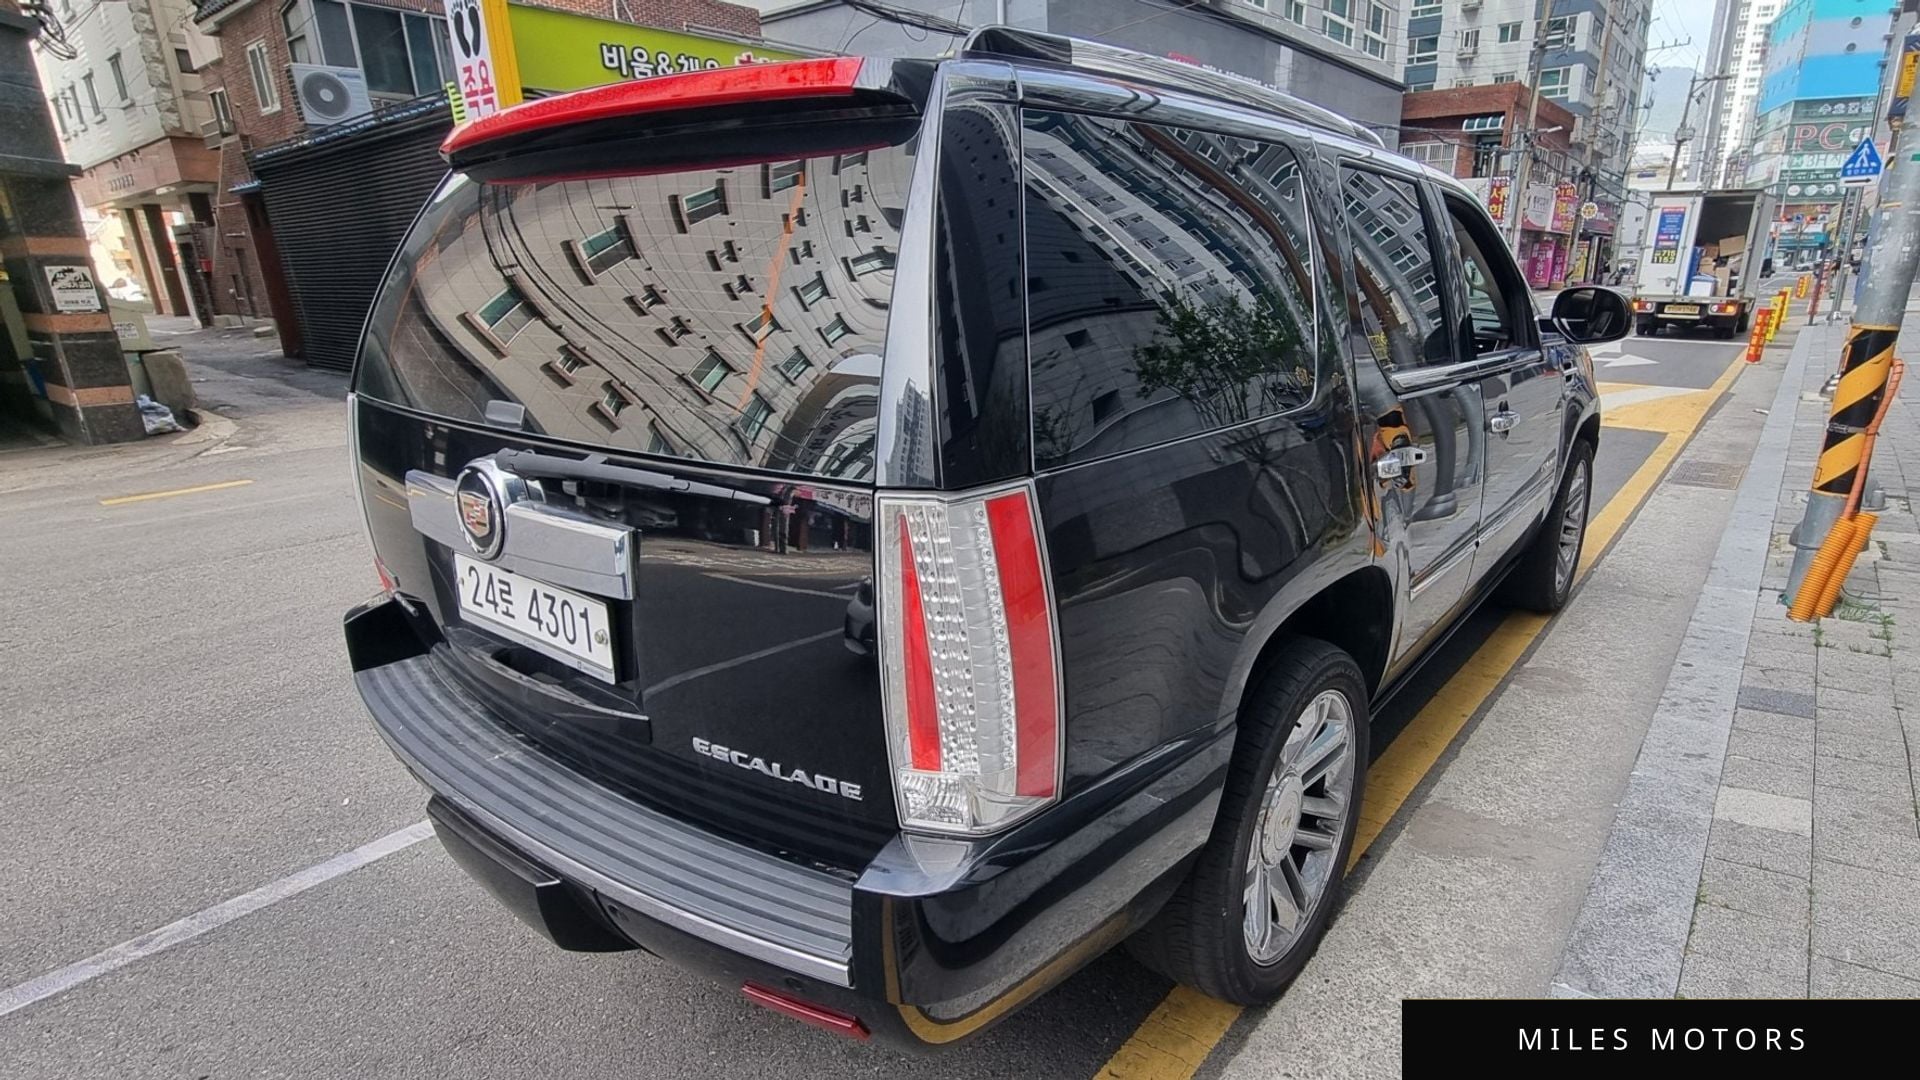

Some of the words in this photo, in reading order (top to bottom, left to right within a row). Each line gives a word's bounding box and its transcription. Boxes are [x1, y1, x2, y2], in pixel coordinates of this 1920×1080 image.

[1792, 123, 1847, 151] PC
[468, 566, 515, 619] 24로
[528, 588, 593, 653] 4301
[692, 737, 863, 801] ESCALADE
